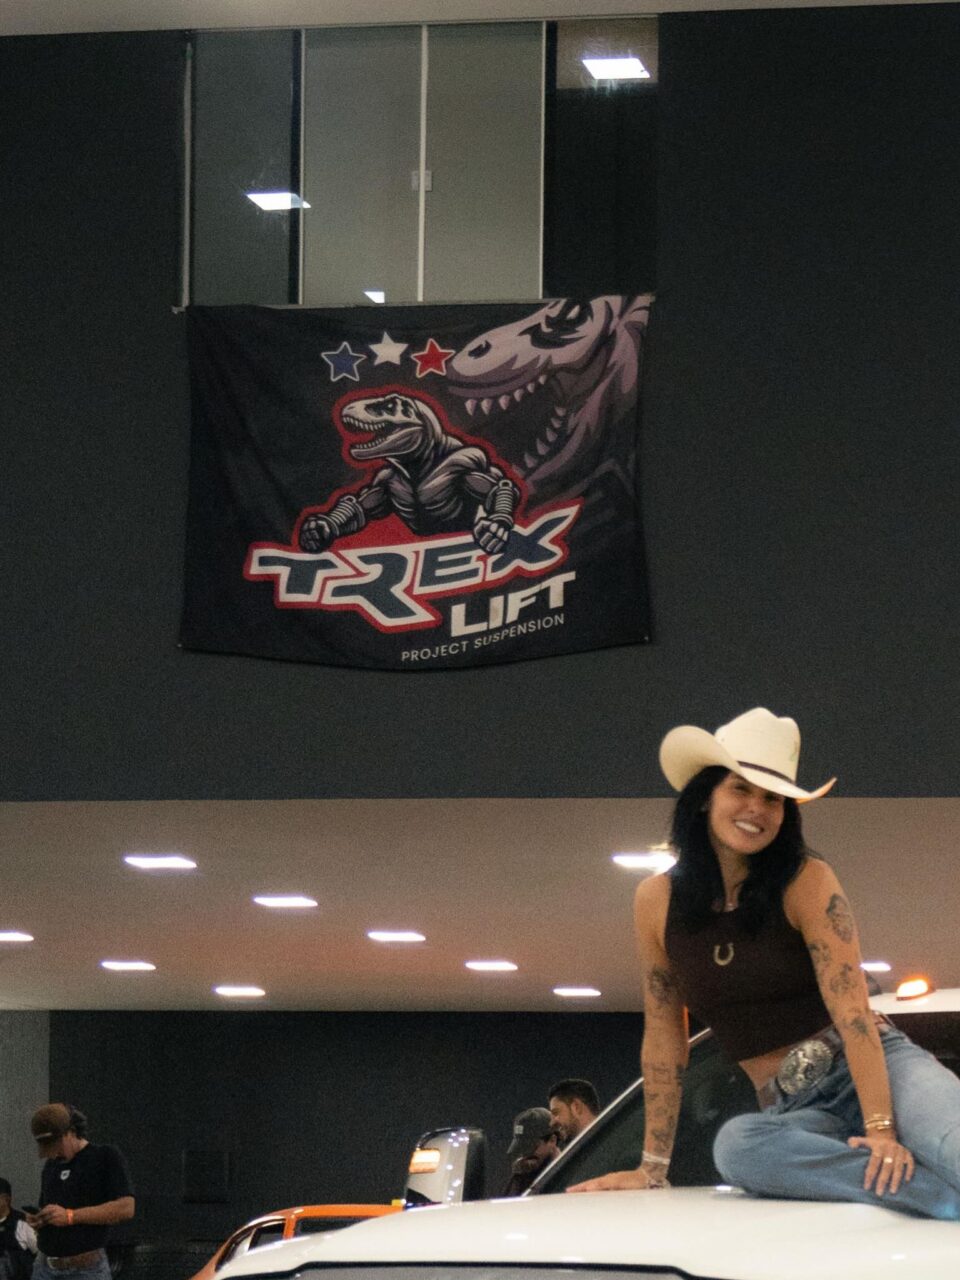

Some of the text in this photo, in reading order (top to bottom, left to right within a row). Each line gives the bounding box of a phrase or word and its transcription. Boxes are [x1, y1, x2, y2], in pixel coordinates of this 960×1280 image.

[451, 571, 576, 637] LIFT
[401, 613, 564, 662] PROJECT SUSPENSION
